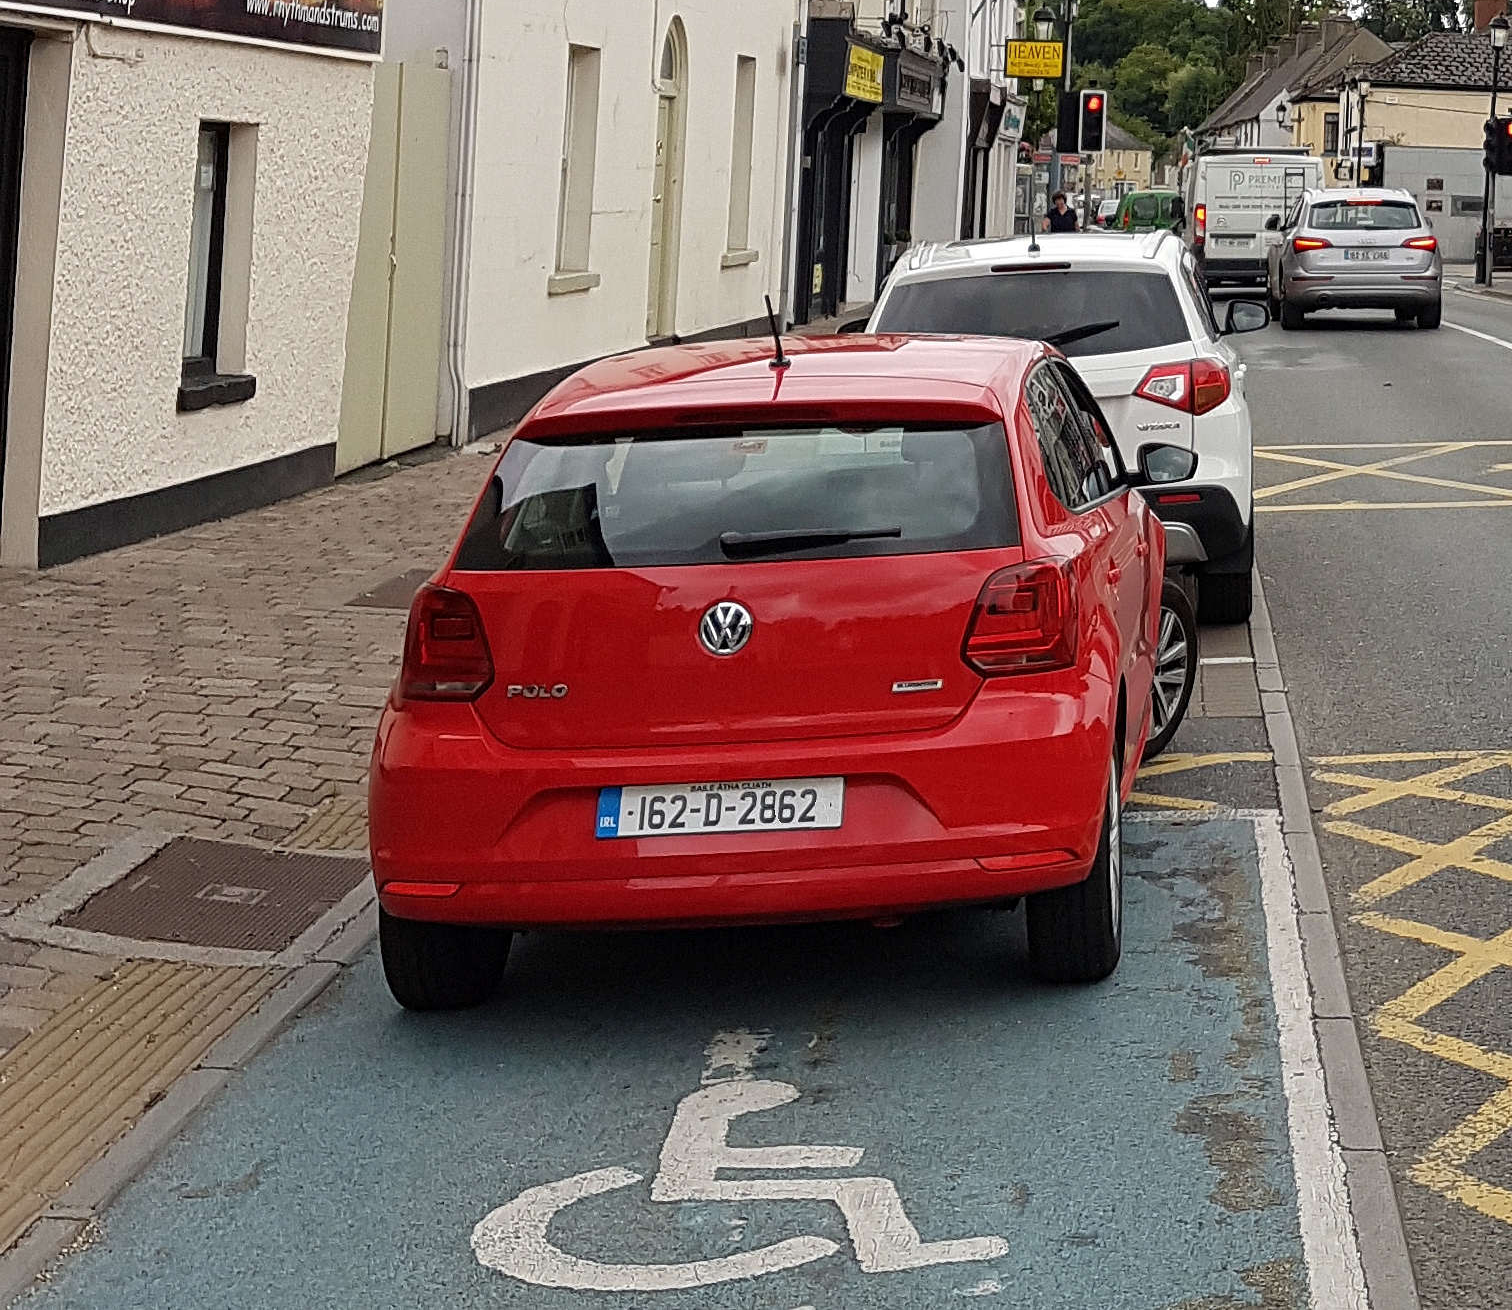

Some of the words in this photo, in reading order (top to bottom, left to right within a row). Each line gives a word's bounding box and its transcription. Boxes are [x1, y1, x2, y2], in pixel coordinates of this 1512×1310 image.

[1009, 44, 1060, 60] HEAVEN
[507, 683, 569, 699] POLO
[638, 788, 818, 830] 162-D-2862
[599, 816, 617, 828] IRL
